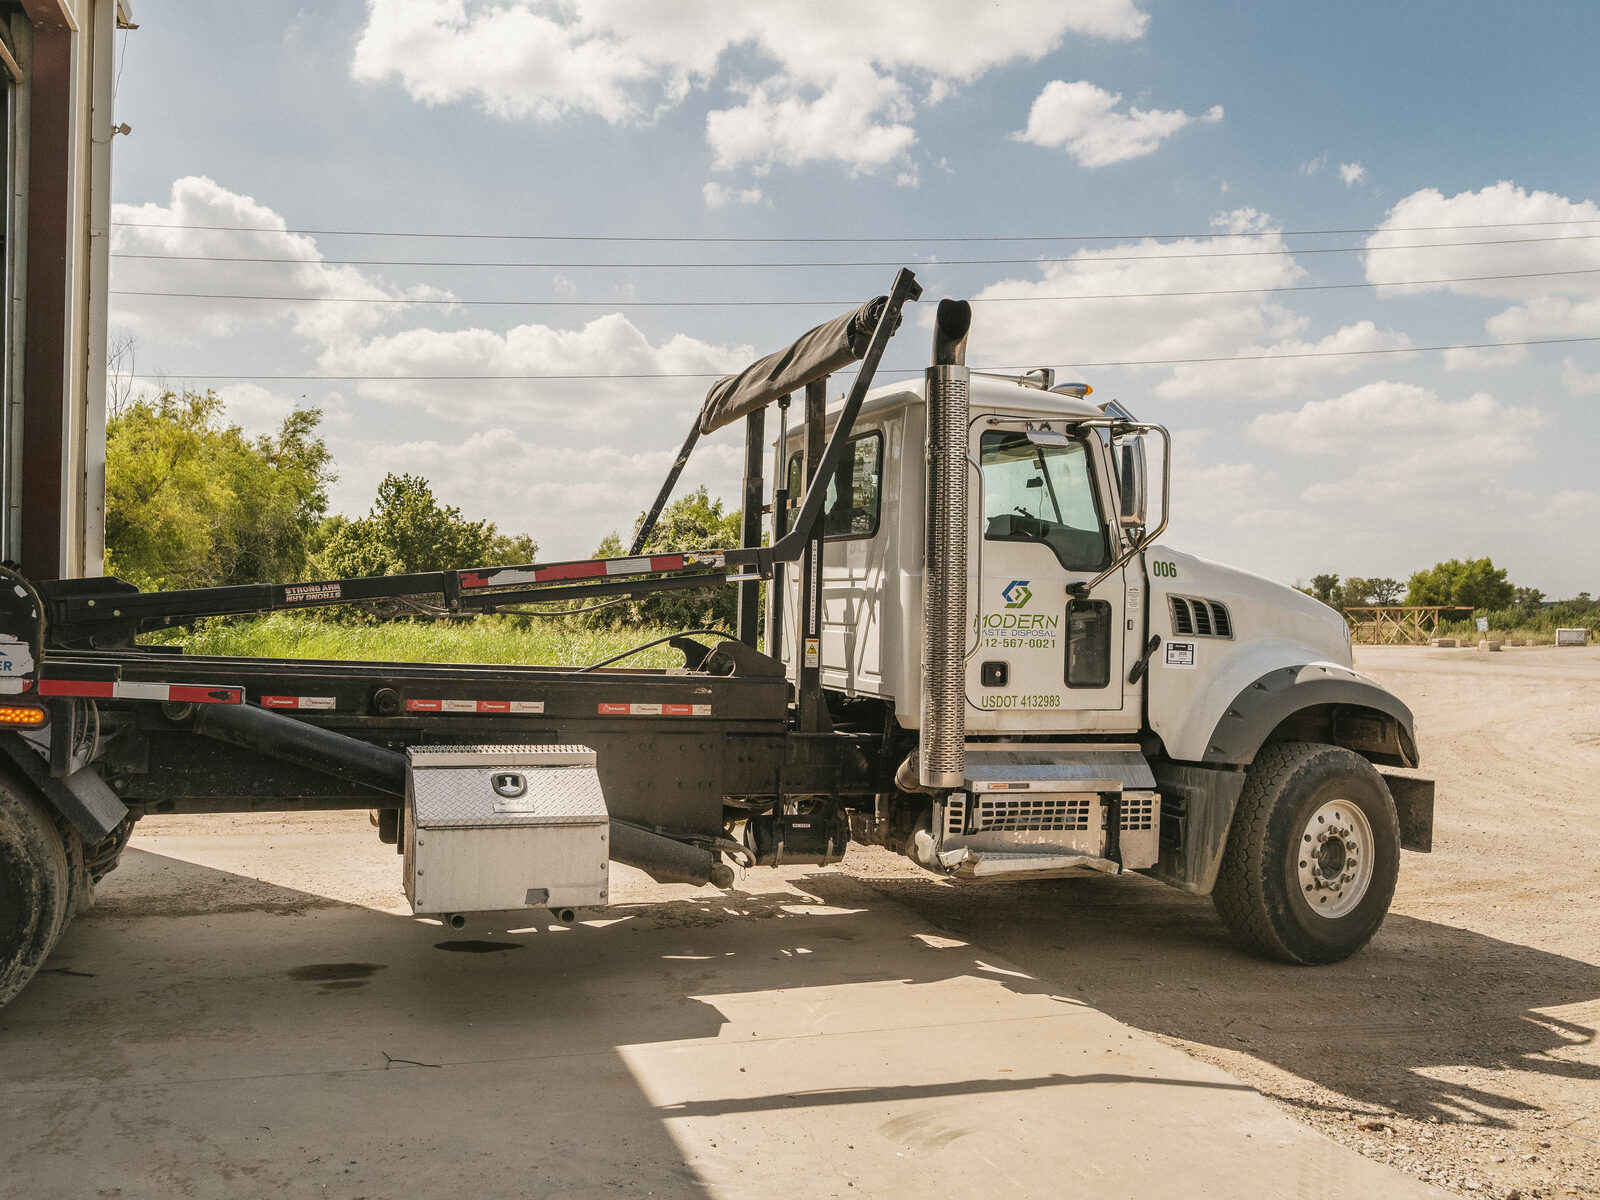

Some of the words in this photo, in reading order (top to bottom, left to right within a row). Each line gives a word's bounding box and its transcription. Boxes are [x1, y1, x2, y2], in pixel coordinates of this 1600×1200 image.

[1153, 560, 1177, 578] 006
[285, 586, 320, 594] STRONG
[973, 614, 1058, 628] MODERN
[980, 638, 1055, 648] 12-567-0021
[982, 696, 1018, 708] USDOT
[1020, 695, 1060, 707] 4132983
